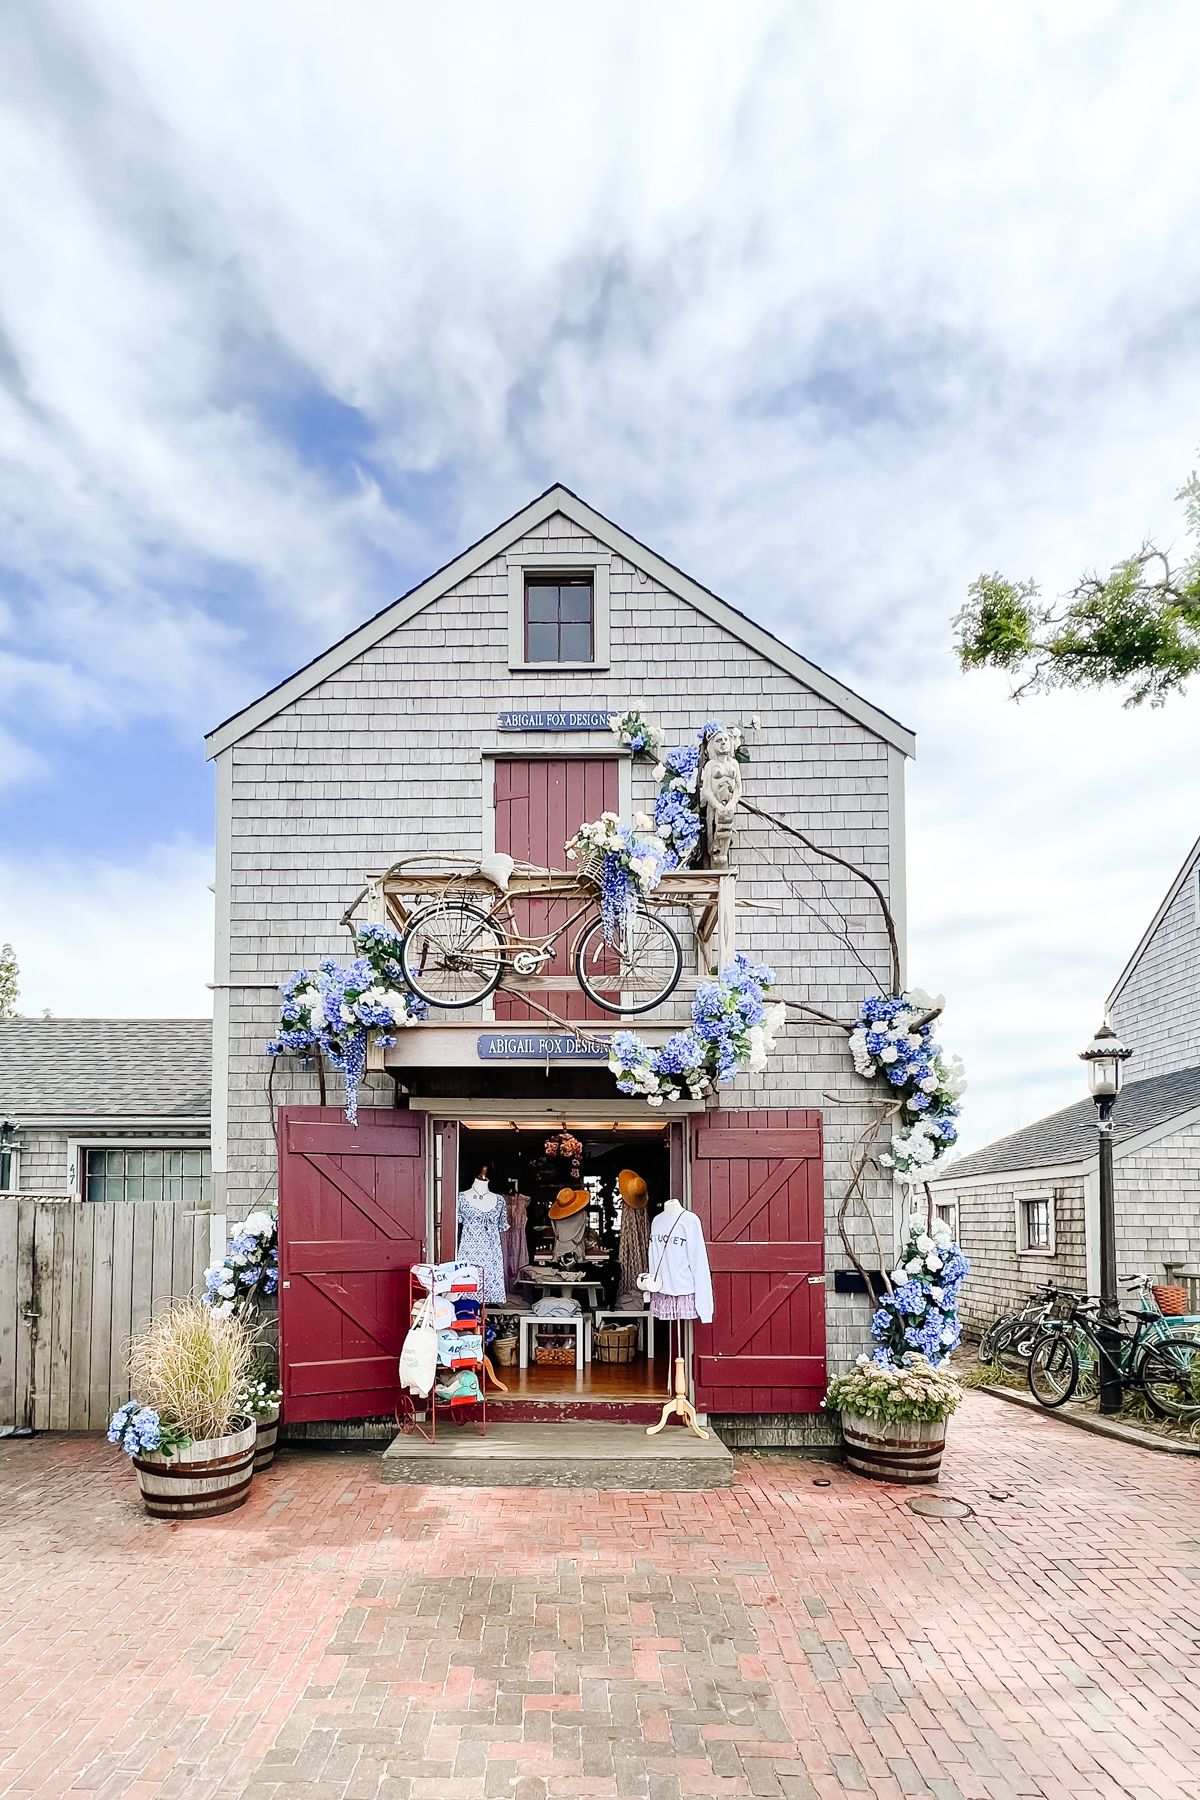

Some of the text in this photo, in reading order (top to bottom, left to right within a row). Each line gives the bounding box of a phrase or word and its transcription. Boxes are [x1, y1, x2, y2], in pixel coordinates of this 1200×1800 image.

[505, 713, 544, 727] ABIGAIL
[546, 713, 566, 726] FOX
[488, 1038, 610, 1054] ABIGAIL FOX DESIGN
[69, 1163, 76, 1185] 47
